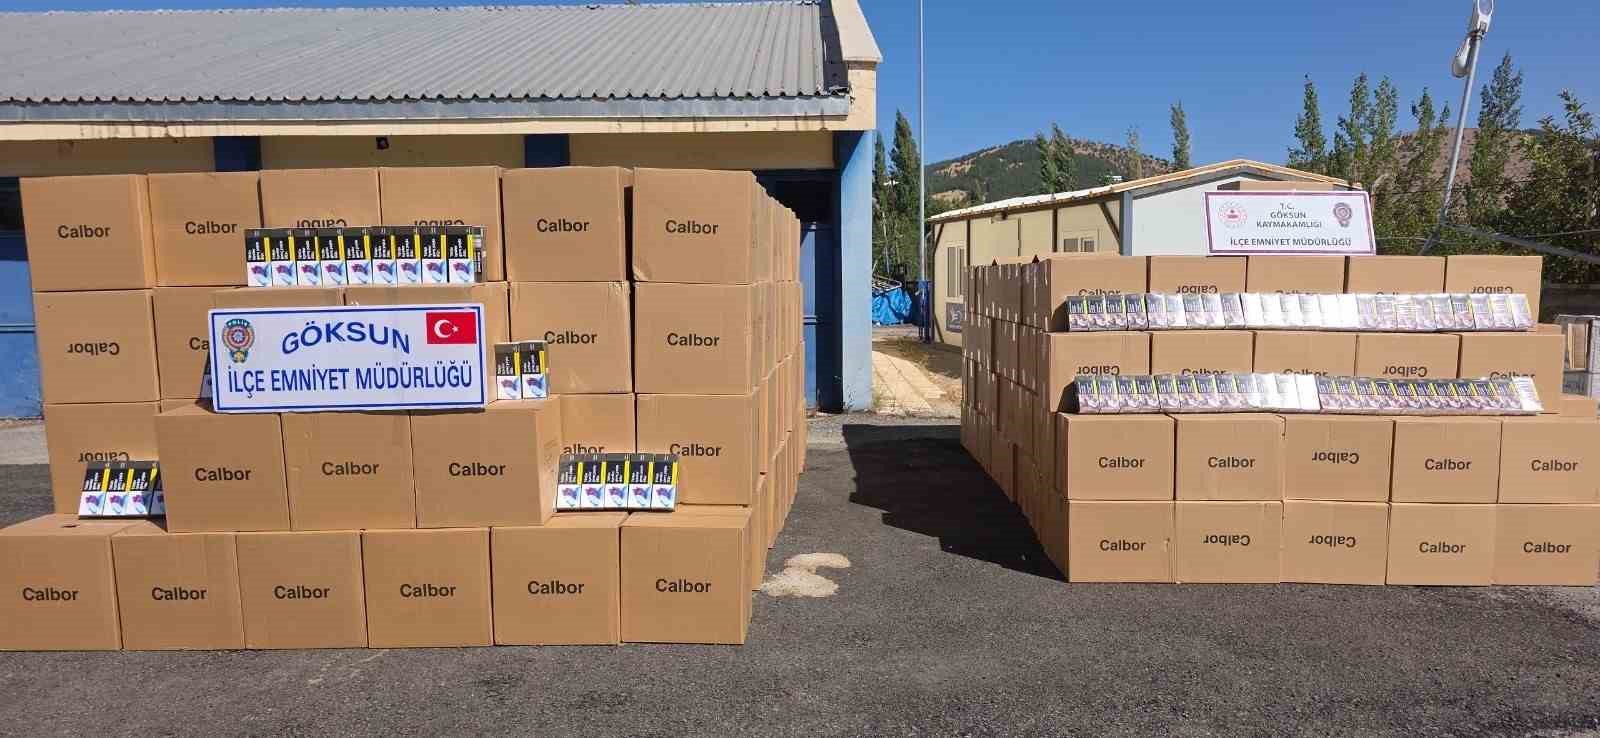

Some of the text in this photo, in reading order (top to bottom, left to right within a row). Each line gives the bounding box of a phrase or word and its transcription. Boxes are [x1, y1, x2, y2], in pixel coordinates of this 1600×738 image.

[1280, 202, 1295, 211] T.C.
[1270, 211, 1307, 220] GÖKSUN
[58, 225, 110, 238] Calbor
[185, 221, 237, 234] Calbor
[537, 218, 590, 232] Calbor
[666, 220, 718, 234] Calbor
[1230, 237, 1352, 247] İLÇE EMNİYET MÜDÜRLÜĞÜ
[281, 321, 411, 355] GÖKSUN
[544, 331, 597, 346] Calbor
[667, 333, 719, 347] Calbor
[67, 342, 120, 356] Calbor
[1383, 365, 1427, 378] Calbor
[228, 365, 265, 399] İLÇE
[271, 364, 350, 391] EMNİYET
[355, 360, 473, 391] MÜDÜRLÜĞÜ
[562, 443, 604, 455] albor
[669, 443, 722, 457] Calbor
[1099, 457, 1144, 468] Calbor
[1208, 457, 1255, 468] Calbor
[1312, 452, 1359, 464] Calbor
[1425, 459, 1472, 470] Calbor
[322, 462, 379, 475] Calbor
[449, 462, 506, 476] Calbor
[1531, 460, 1578, 471] Calbor
[195, 467, 251, 481] Calbor
[1100, 540, 1146, 551] Calbor
[1203, 535, 1250, 546] Calbor
[1309, 535, 1356, 548] Calbor
[1419, 542, 1466, 553] Calbor
[1524, 542, 1571, 553] Calbor
[274, 585, 330, 599] Calbor
[400, 584, 456, 597] Calbor
[528, 580, 584, 594] Calbor
[656, 579, 711, 592] Calbor
[23, 587, 79, 601] Calbor
[152, 587, 207, 600] Calbor
